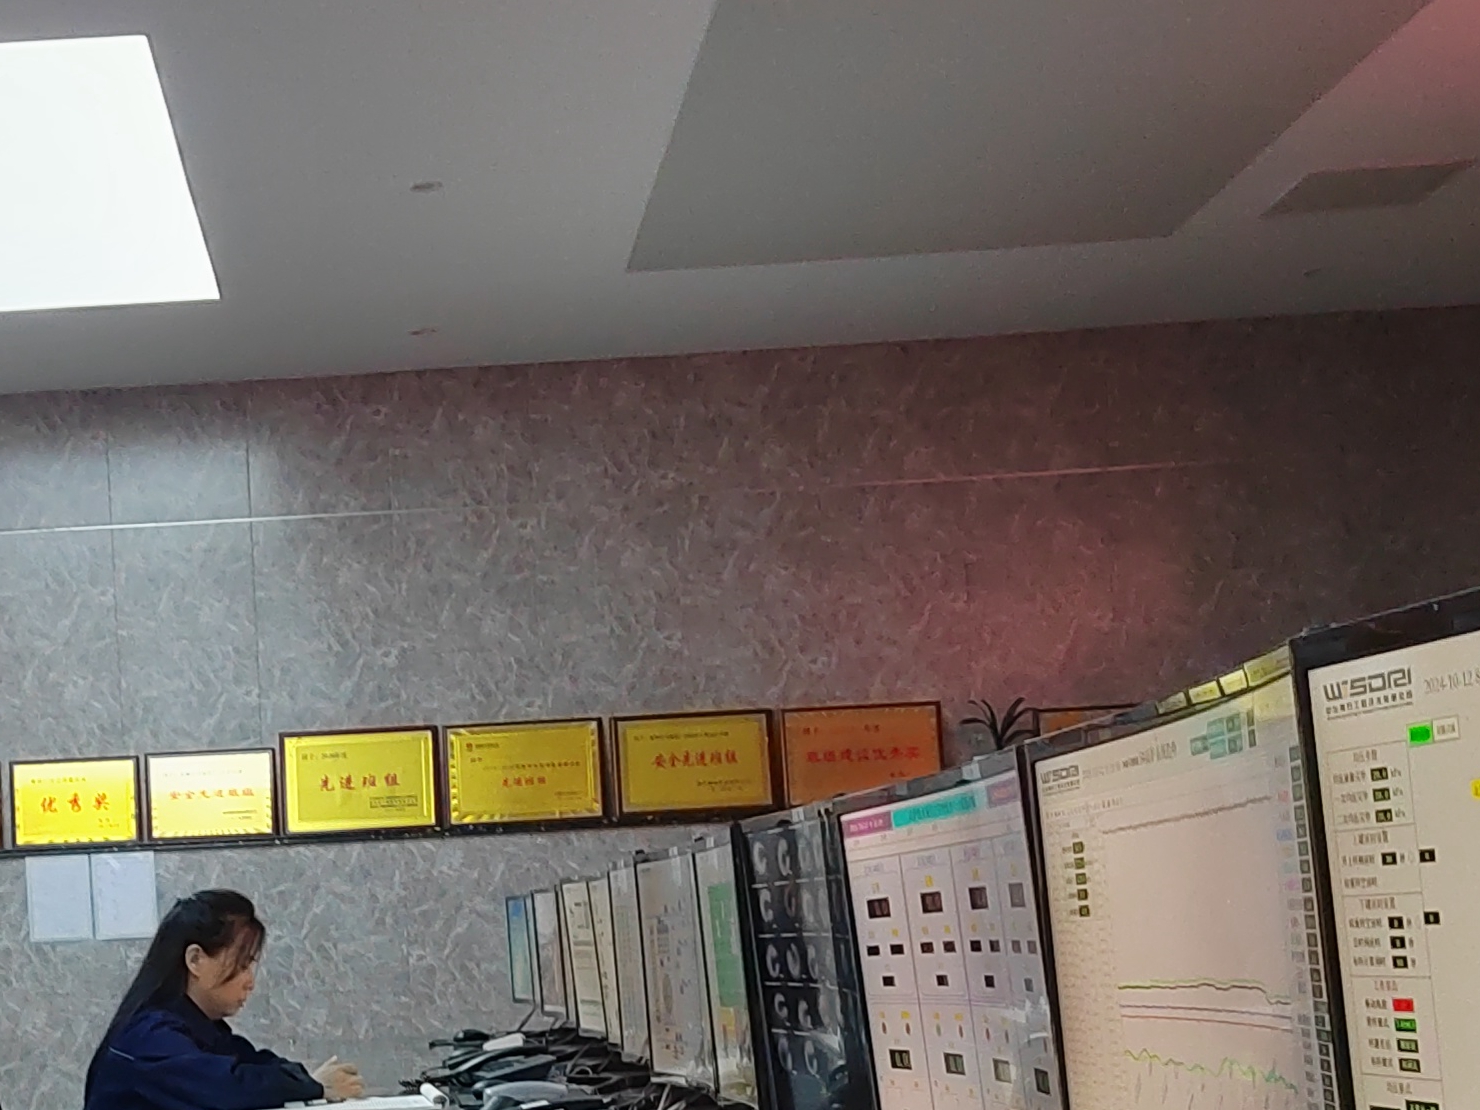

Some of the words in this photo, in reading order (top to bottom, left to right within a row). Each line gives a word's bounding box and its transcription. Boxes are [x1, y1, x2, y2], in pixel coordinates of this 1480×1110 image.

[319, 772, 401, 792] 先进班组
[40, 792, 110, 813] 优秀奖
